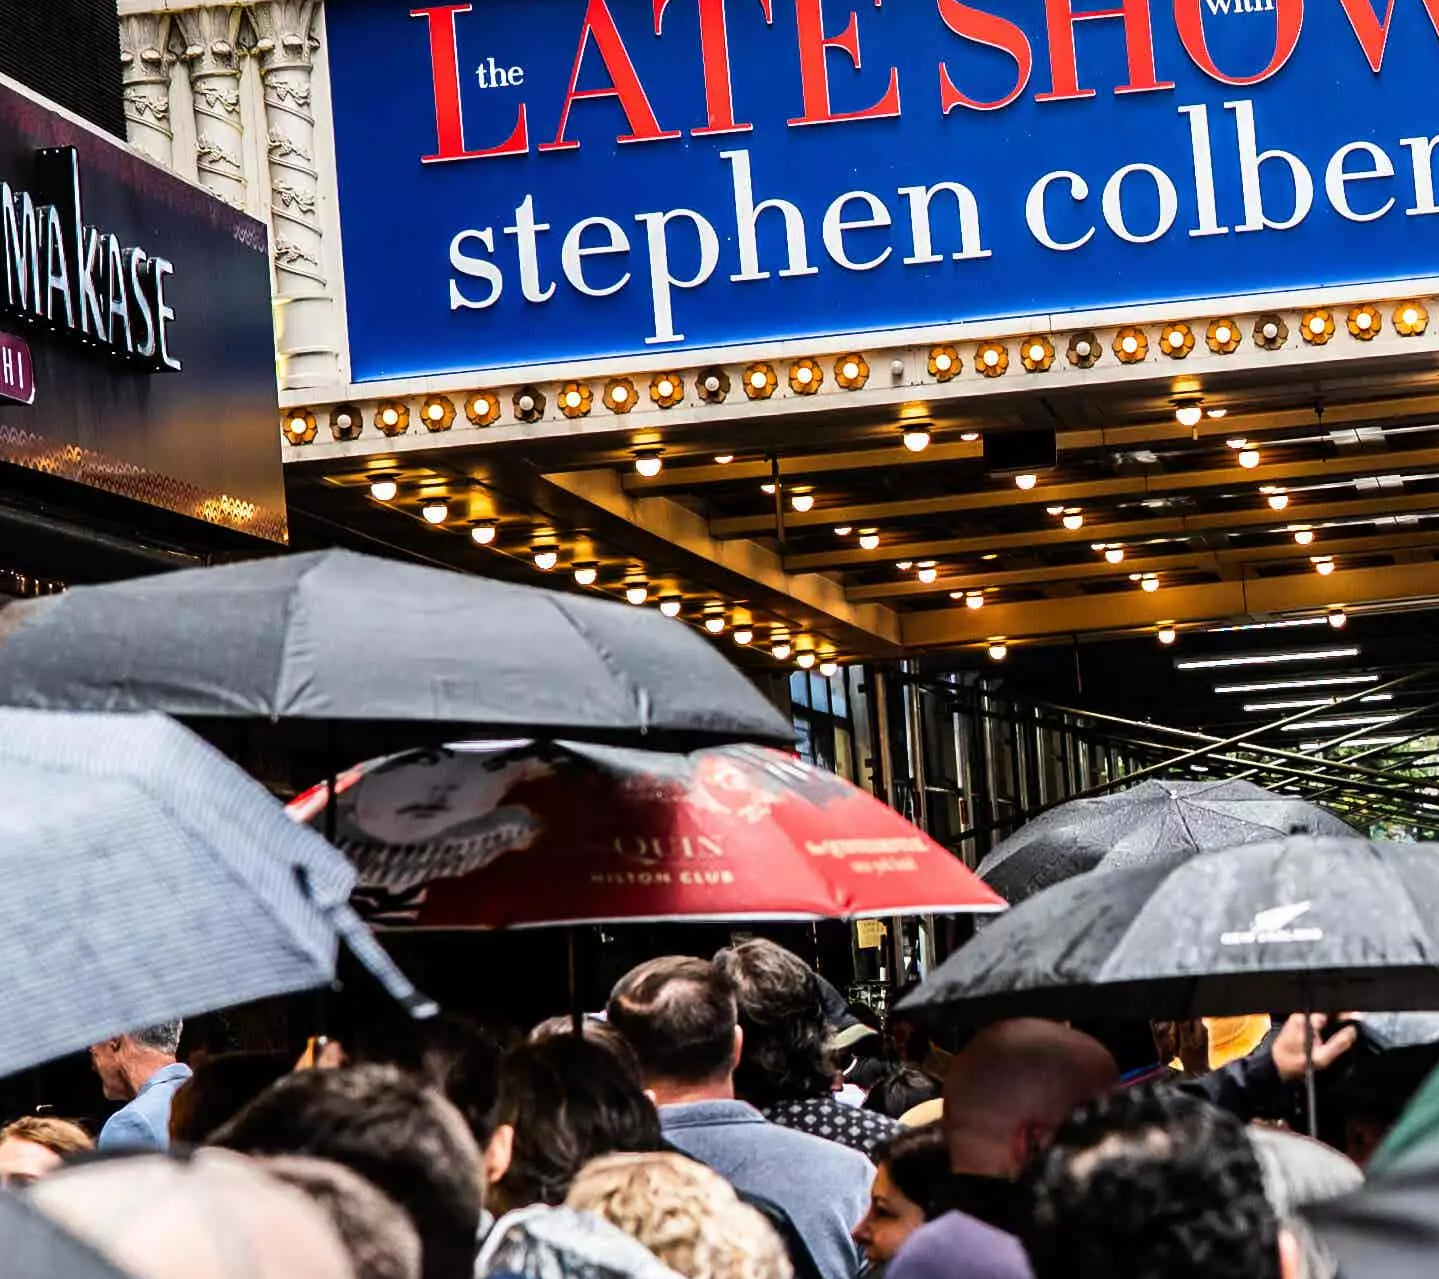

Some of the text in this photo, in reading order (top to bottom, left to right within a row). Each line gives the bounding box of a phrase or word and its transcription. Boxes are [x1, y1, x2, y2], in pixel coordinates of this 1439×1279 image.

[474, 56, 526, 89] the
[448, 148, 993, 344] stephen
[680, 870, 734, 884] CLUB
